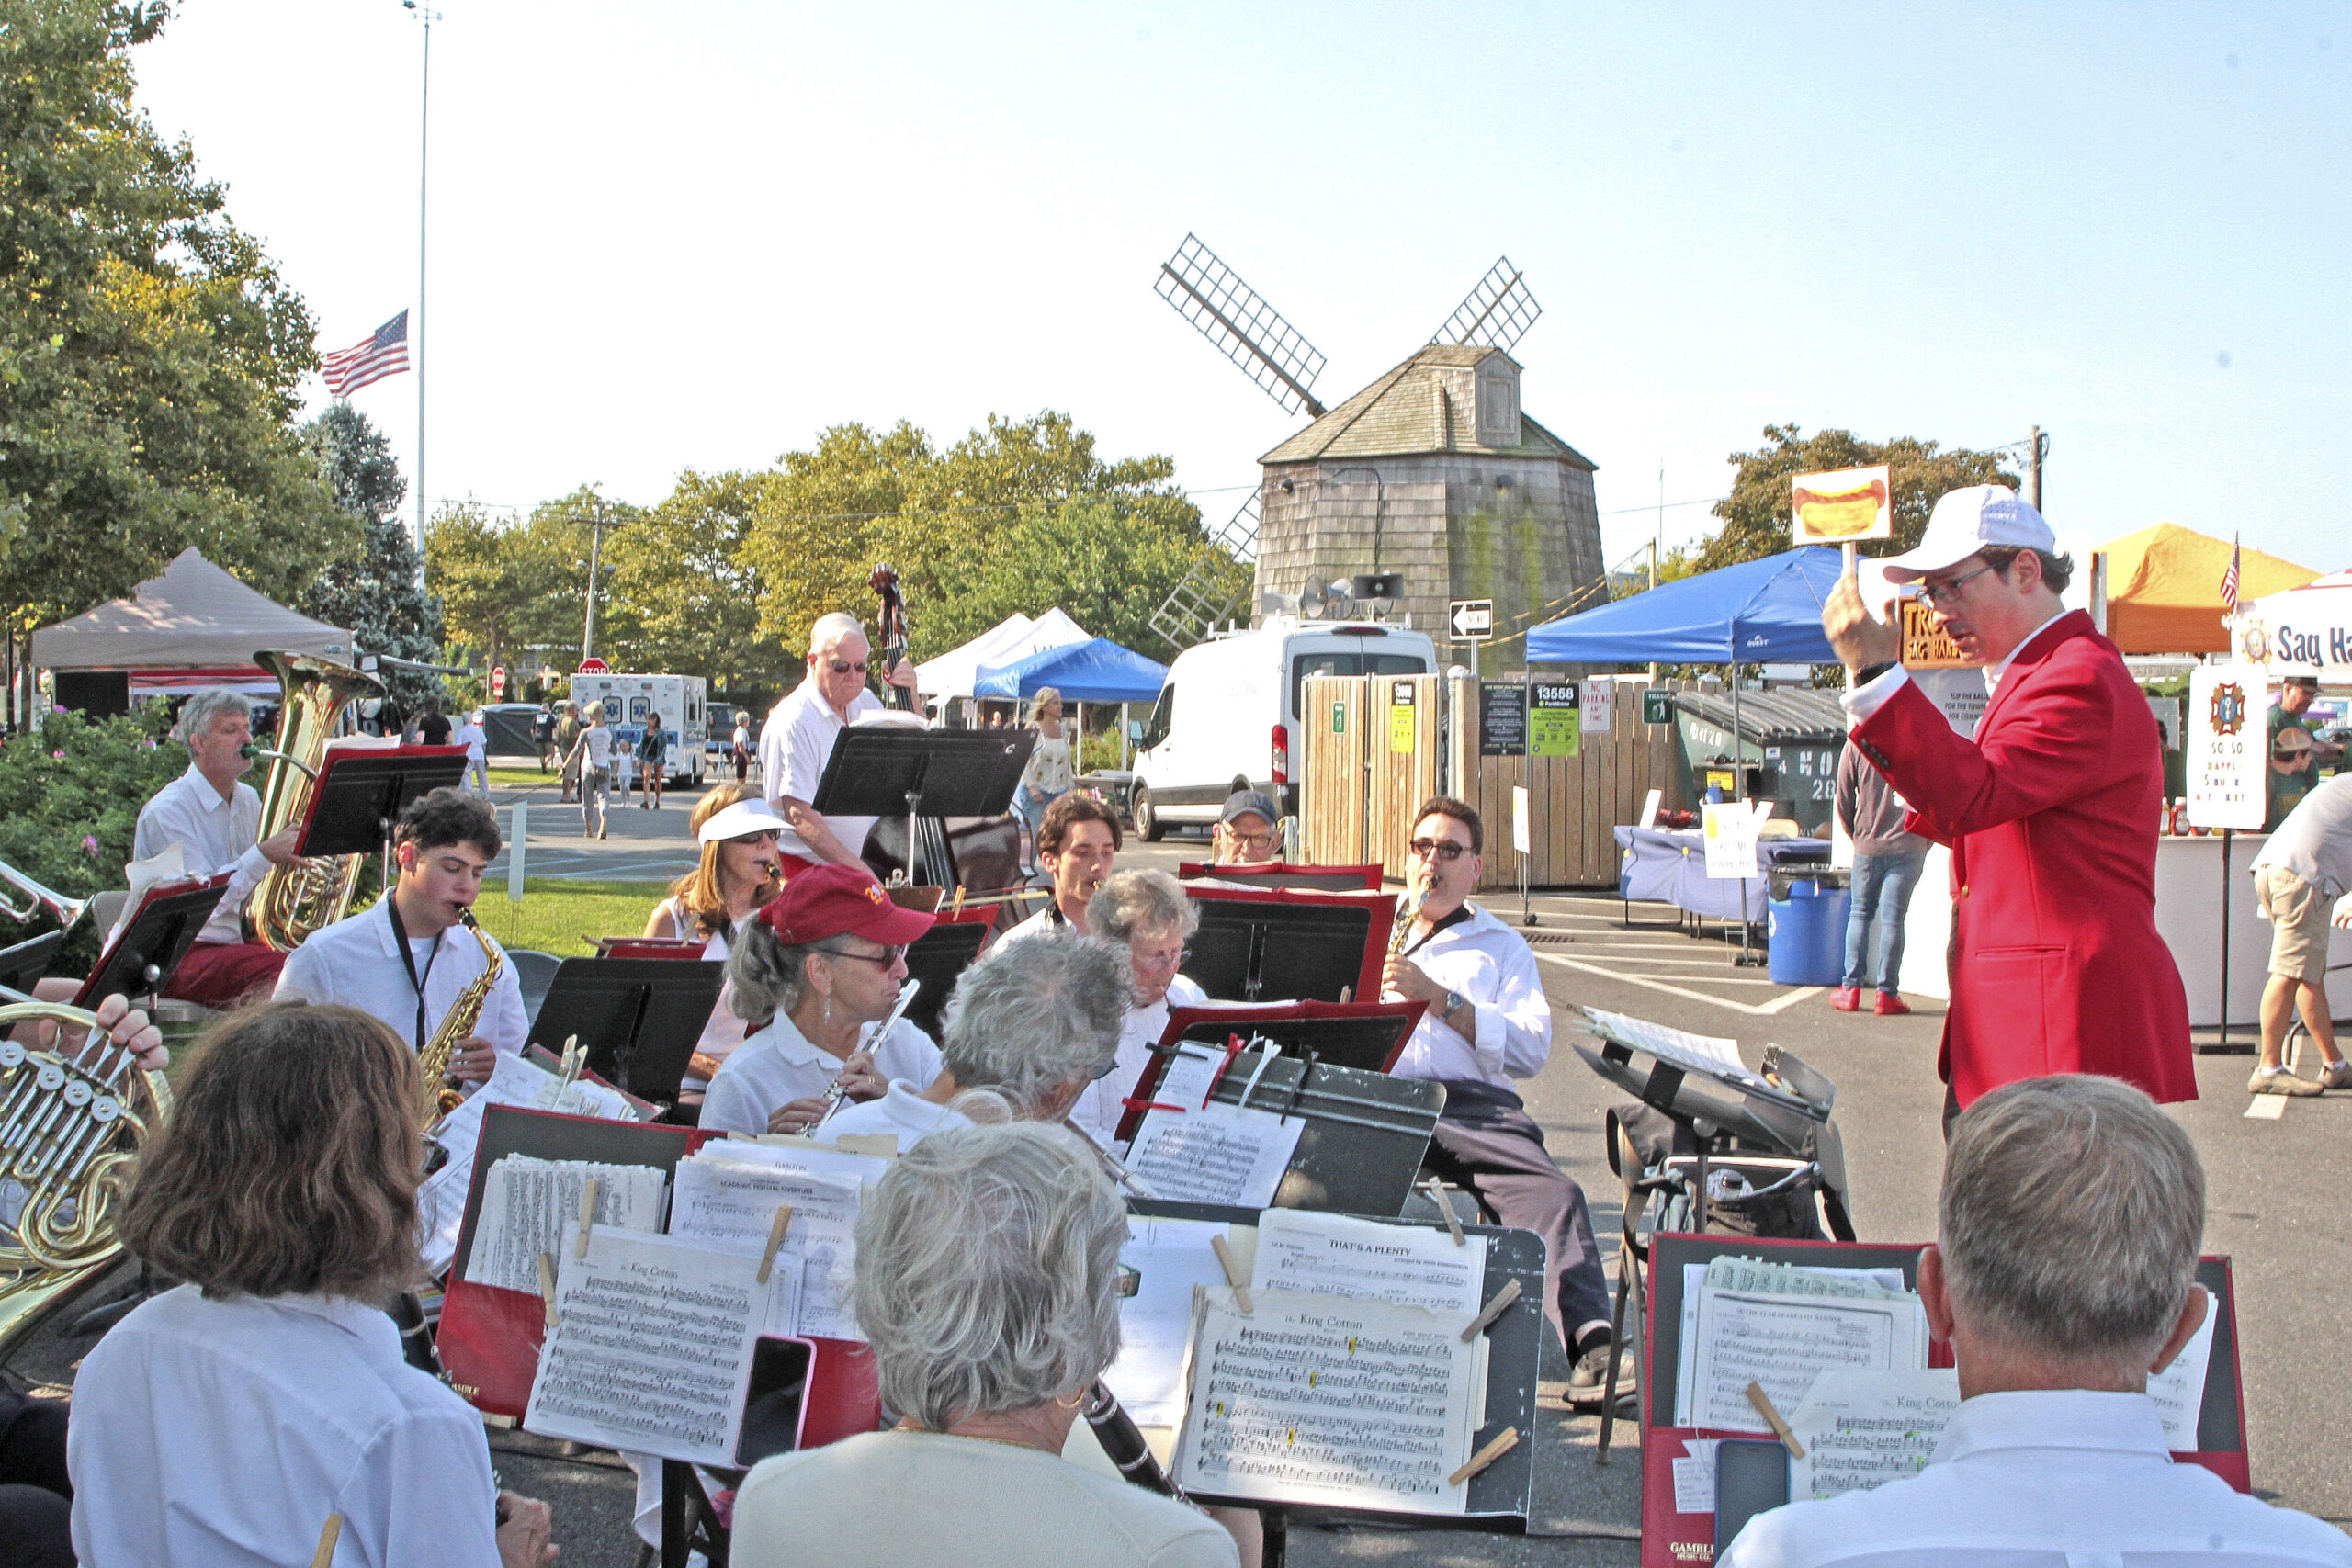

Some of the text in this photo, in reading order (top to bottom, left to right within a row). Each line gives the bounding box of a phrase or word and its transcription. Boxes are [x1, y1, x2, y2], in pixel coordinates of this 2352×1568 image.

[1906, 639, 1928, 660] SAG
[2278, 626, 2324, 667] Sag
[1591, 682, 1601, 692] NO
[1582, 694, 1610, 705] PARKING
[1329, 1239, 1412, 1257] THAT'S A PLENTY
[630, 1262, 649, 1275] King
[650, 1265, 678, 1280] Cotton
[1300, 1314, 1323, 1327] King
[1327, 1316, 1363, 1329] Cotton
[1897, 1396, 1922, 1410] King
